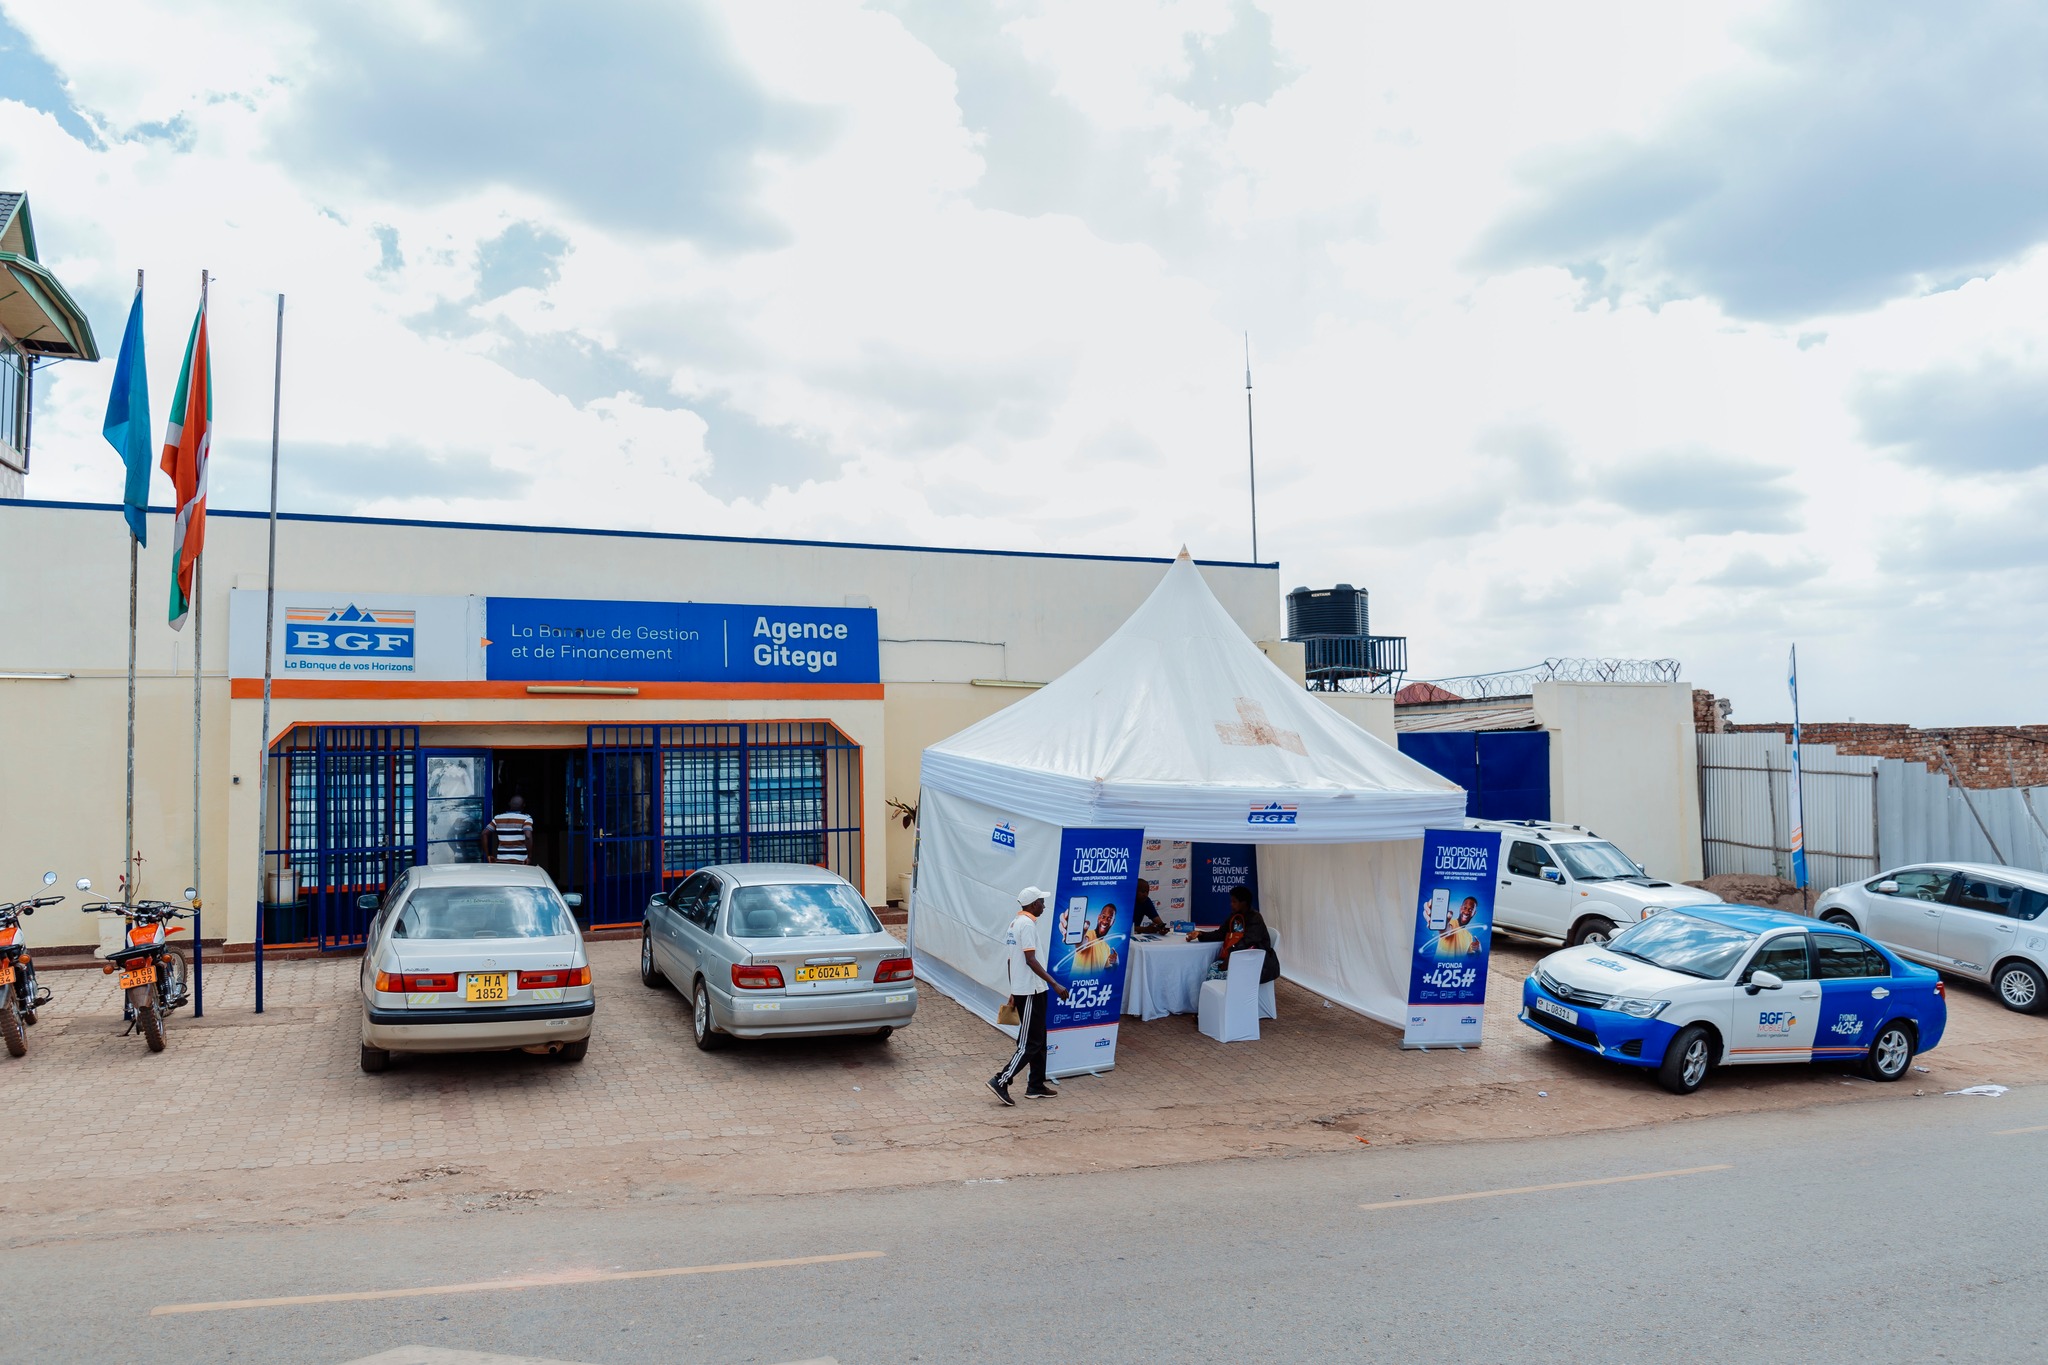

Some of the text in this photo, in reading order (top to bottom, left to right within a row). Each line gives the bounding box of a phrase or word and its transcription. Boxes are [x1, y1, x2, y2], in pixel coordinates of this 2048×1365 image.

[511, 623, 699, 641] La Banque de Gestion
[753, 616, 848, 645] Agence
[292, 631, 409, 651] BGF
[511, 644, 673, 660] et de Financement
[754, 644, 837, 673] Gitega
[285, 660, 297, 668] La
[300, 660, 337, 671] Banque
[339, 661, 351, 670] de
[372, 662, 413, 671] Horizons
[1250, 814, 1295, 822] BGF
[993, 831, 1013, 844] BGF
[1075, 847, 1129, 859] TWOROSHA
[1437, 846, 1488, 857] TWOROSHA
[1073, 859, 1127, 873] UBUZIMA
[1212, 857, 1231, 865] KAZE
[1434, 856, 1487, 870] UBUZIMA
[1212, 867, 1249, 875] BIENVENUE
[1212, 876, 1246, 884] WELCOME
[140, 967, 153, 976] GB
[808, 966, 850, 979] C 6024 A
[129, 976, 153, 987] A 832
[484, 975, 501, 987] H A
[1071, 979, 1099, 987] FYONDA
[475, 987, 503, 1000] 1852
[1759, 1012, 1783, 1025] BGF
[1758, 1024, 1781, 1032] MOBILE
